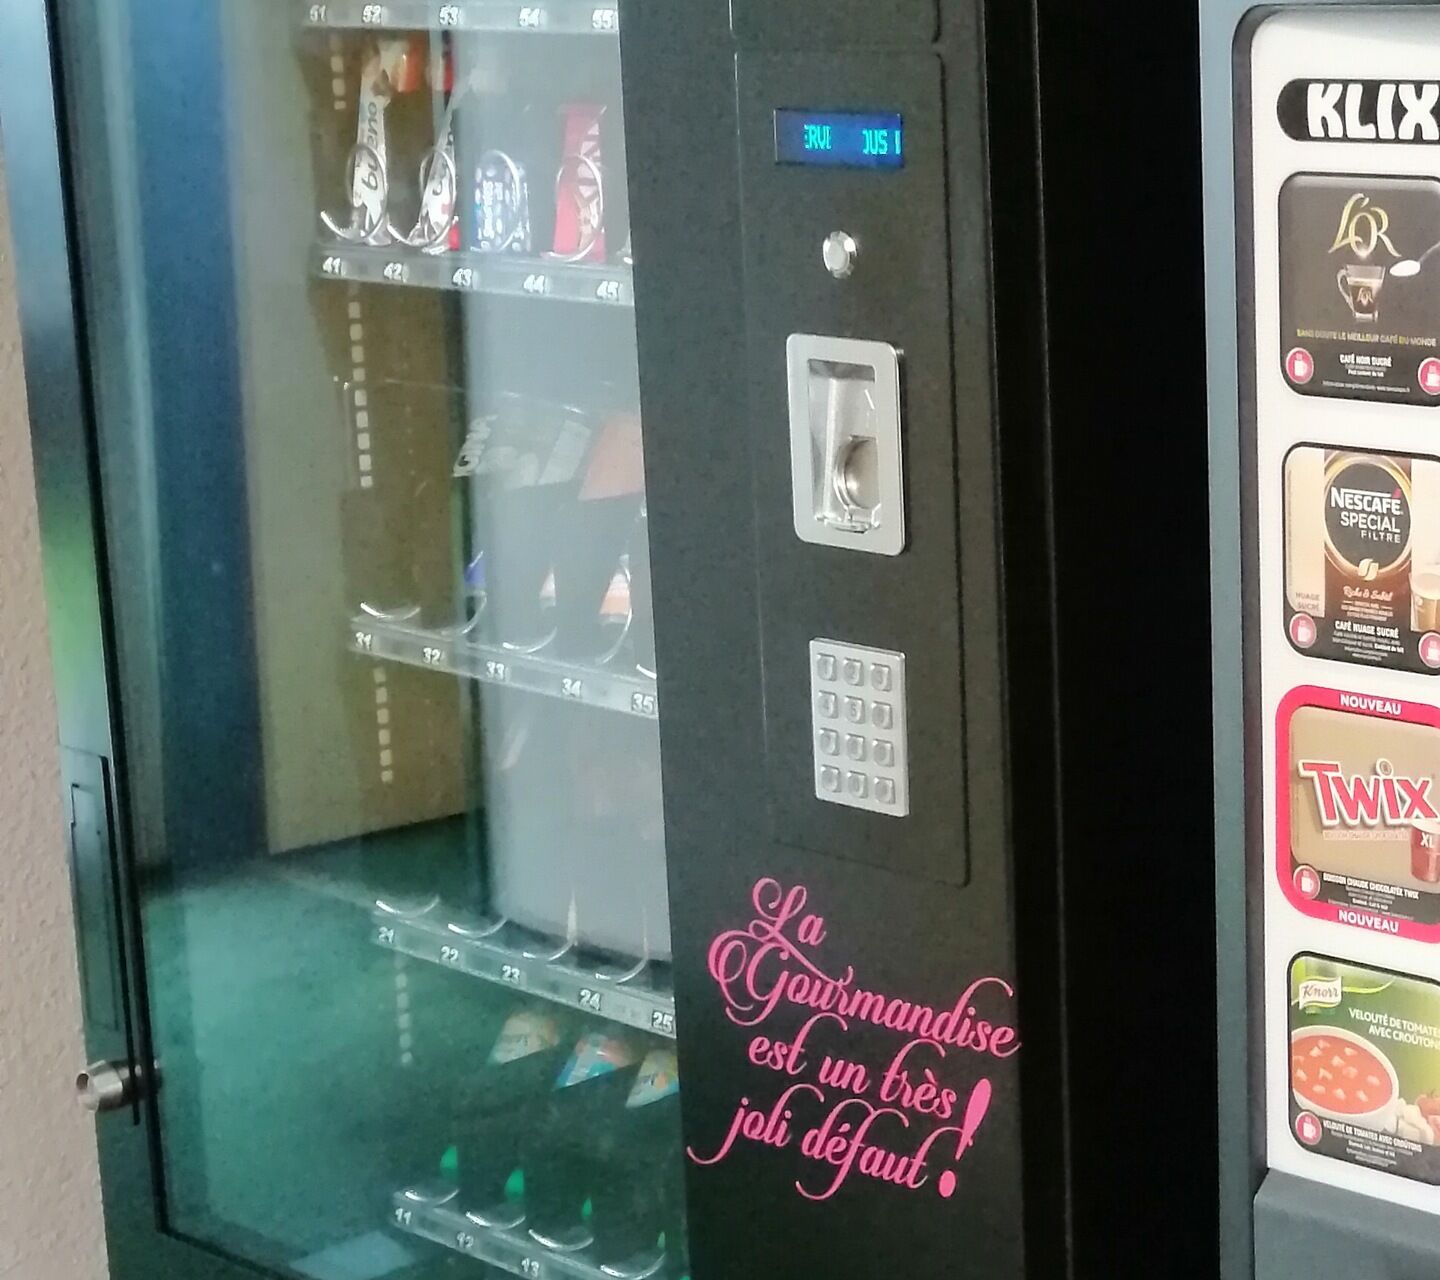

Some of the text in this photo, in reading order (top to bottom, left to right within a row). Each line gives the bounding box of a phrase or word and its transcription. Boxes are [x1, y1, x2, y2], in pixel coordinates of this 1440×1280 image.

[310, 6, 327, 22] 51
[363, 5, 381, 23] 52
[440, 6, 459, 25] 53
[520, 8, 541, 27] 54
[593, 9, 616, 28] 55
[1306, 82, 1440, 139] KLIX
[1329, 193, 1402, 258] L'OR
[384, 263, 405, 280] 42
[597, 281, 621, 300] 45
[1341, 512, 1400, 533] SPECIAL
[1361, 531, 1400, 543] FILTRE
[423, 647, 441, 664] 32
[562, 678, 582, 697] 34
[632, 692, 655, 714] 35
[1340, 694, 1401, 715] NOUVEAU
[1421, 832, 1434, 848] XL
[750, 878, 840, 965] La
[1339, 910, 1398, 933] NOUVEAU
[580, 989, 601, 1011] 24
[708, 930, 1022, 1057] Gourmandise
[1302, 984, 1339, 998] Knorr
[652, 1011, 673, 1033] 25
[1349, 1007, 1389, 1024] VELOUTÉ
[1390, 1018, 1402, 1028] DE
[1369, 1026, 1392, 1038] AVEC
[750, 1013, 957, 1119] est un très
[688, 1084, 824, 1164] joli
[796, 1099, 972, 1200] défaut
[395, 1208, 412, 1225] 11
